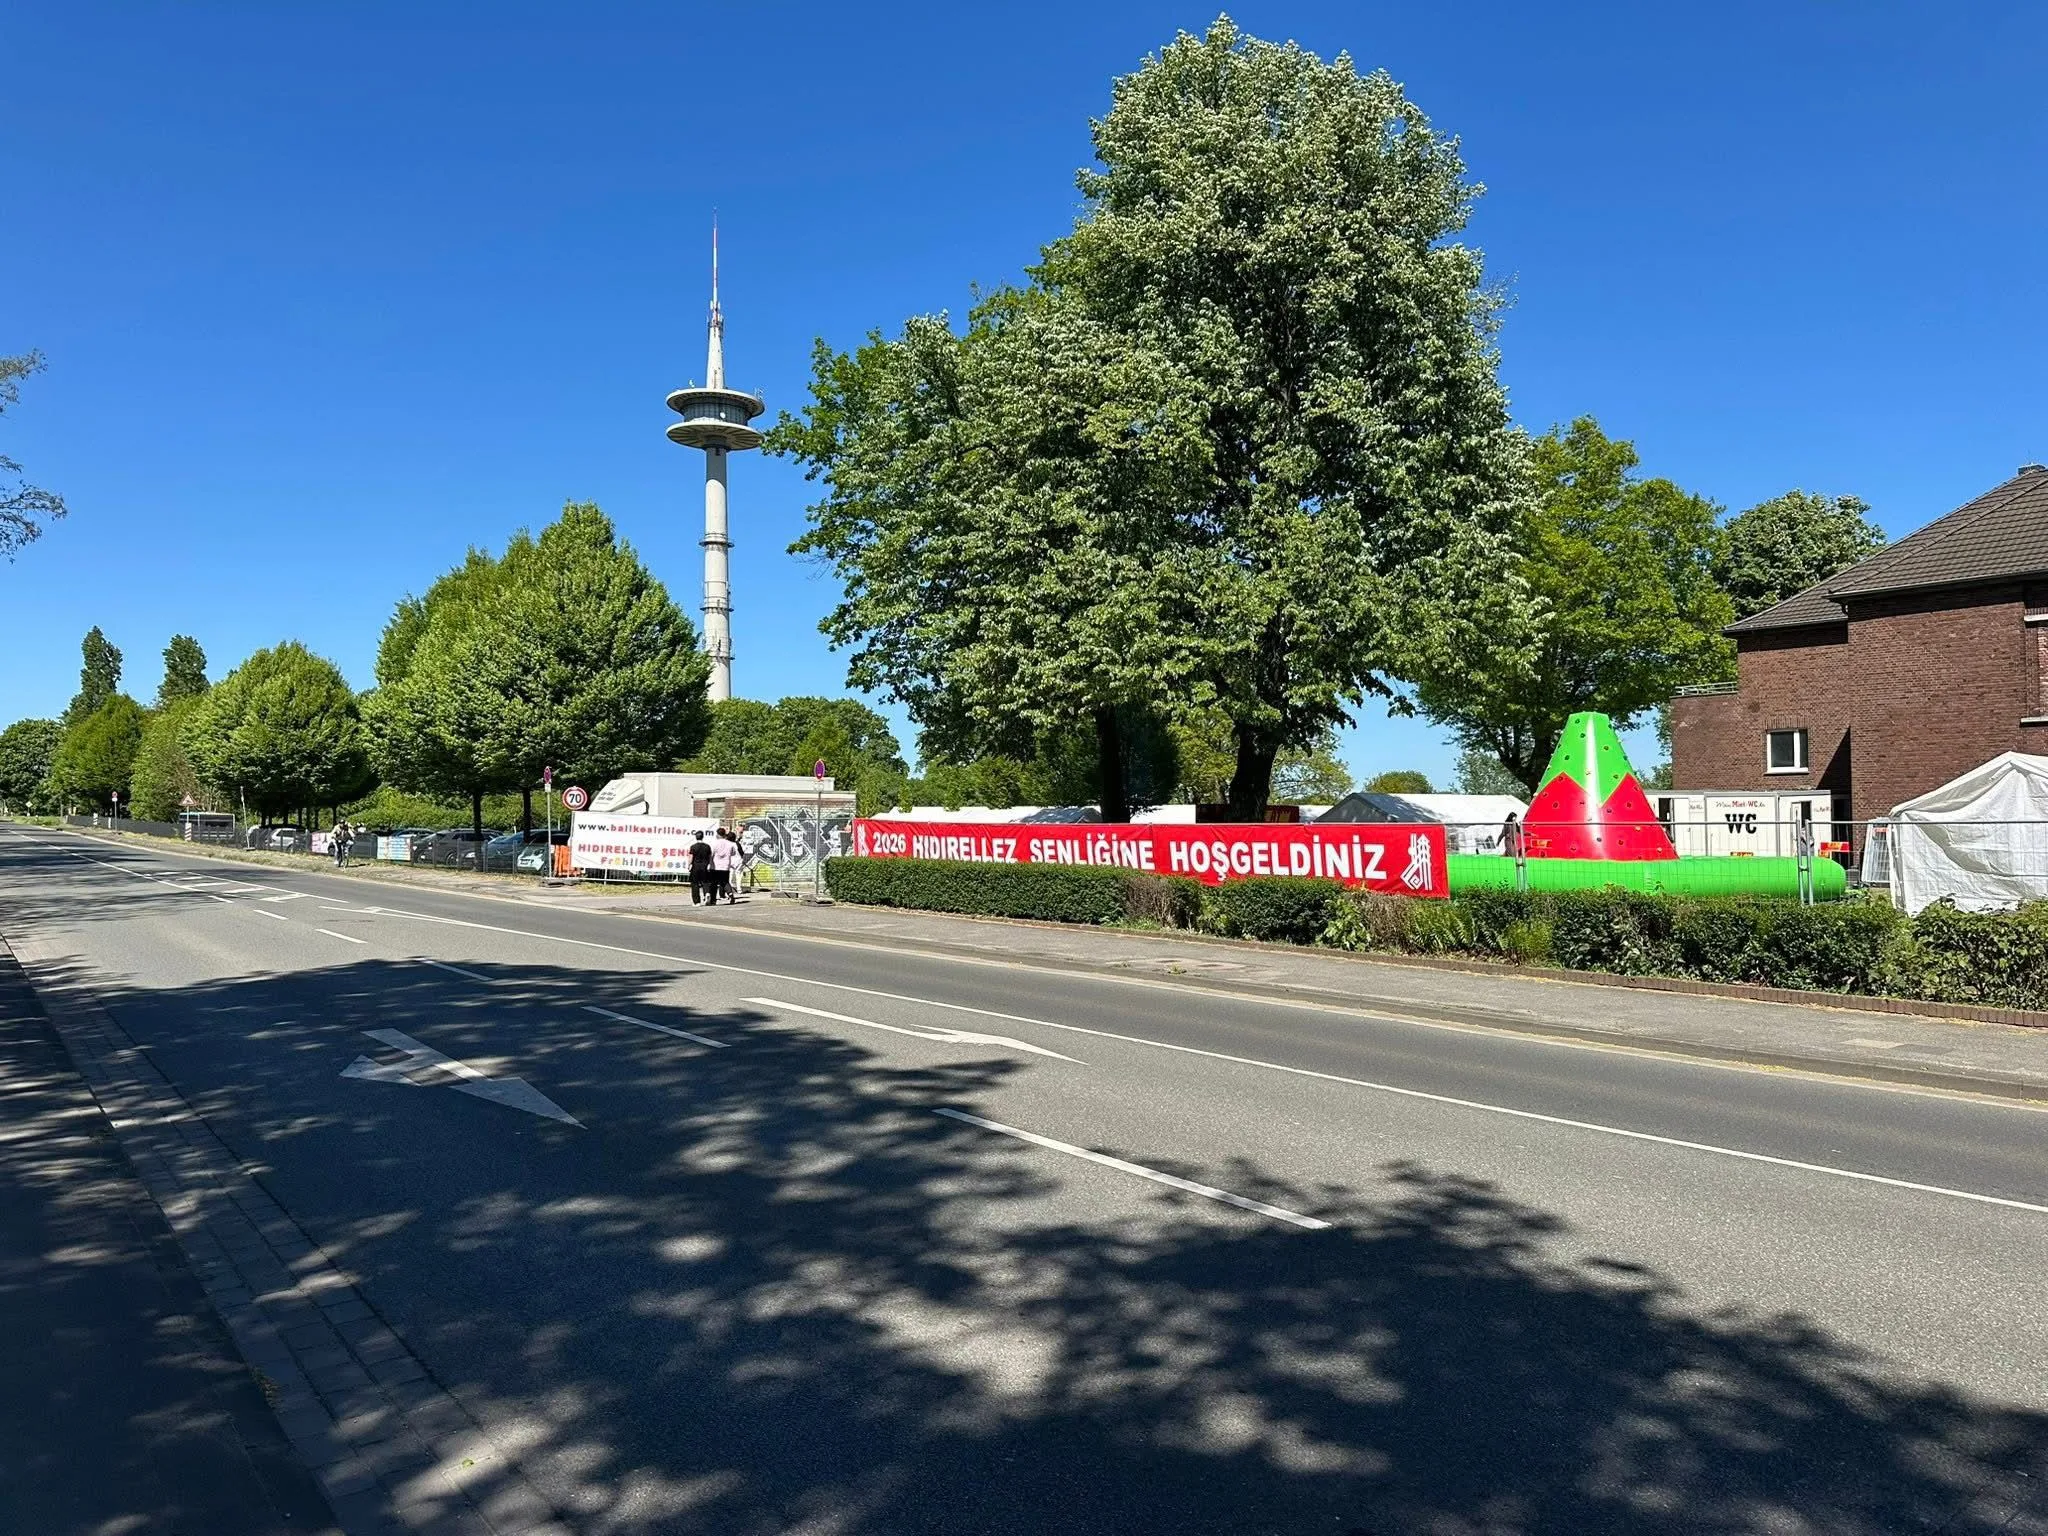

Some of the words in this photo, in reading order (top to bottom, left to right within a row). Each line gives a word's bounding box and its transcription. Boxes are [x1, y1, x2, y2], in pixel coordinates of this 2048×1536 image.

[568, 793, 582, 804] 70
[577, 822, 714, 836] www.balikesirliler.cm
[1724, 813, 1757, 834] WC
[577, 843, 653, 856] HIDIRELLEZ
[872, 831, 907, 854] 2026
[912, 835, 1018, 864] HIDIRELLEZ
[1169, 834, 1388, 882] HOŞGELDİNİZ
